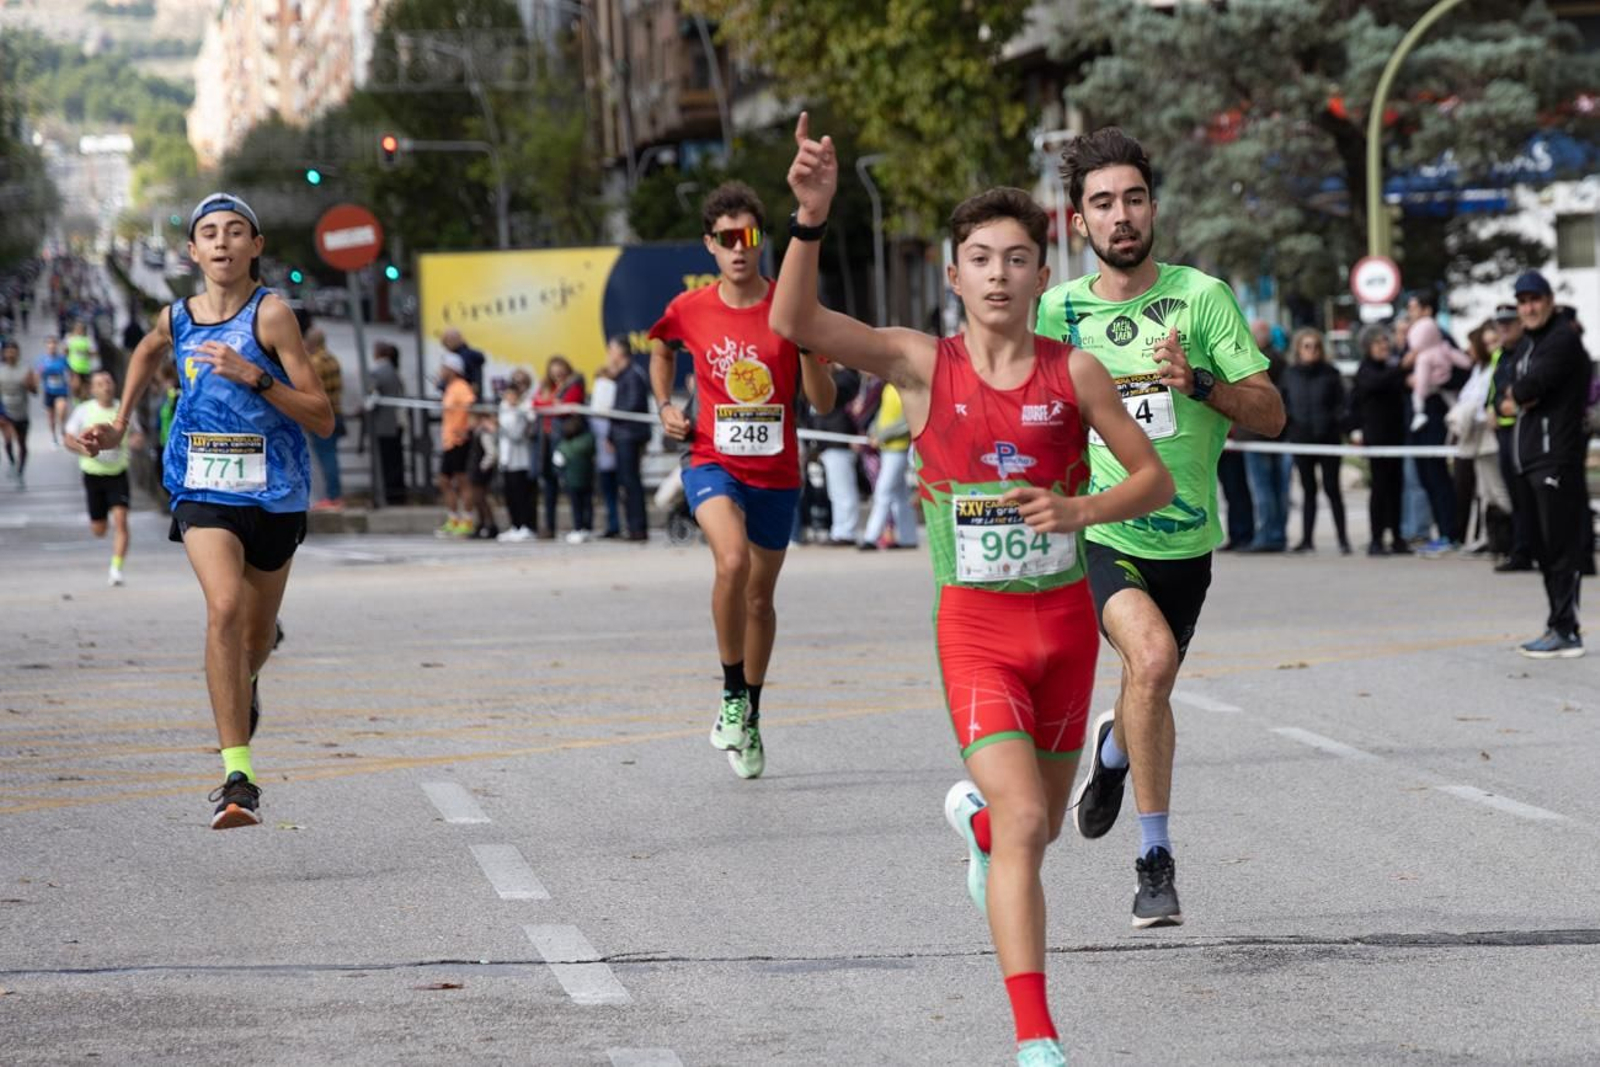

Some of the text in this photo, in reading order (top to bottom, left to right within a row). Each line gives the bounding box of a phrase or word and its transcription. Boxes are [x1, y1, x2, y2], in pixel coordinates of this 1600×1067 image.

[1134, 398, 1154, 424] 4
[729, 425, 769, 443] 248
[203, 457, 244, 479] 771
[959, 500, 983, 517] XXV
[981, 528, 1052, 561] 964
